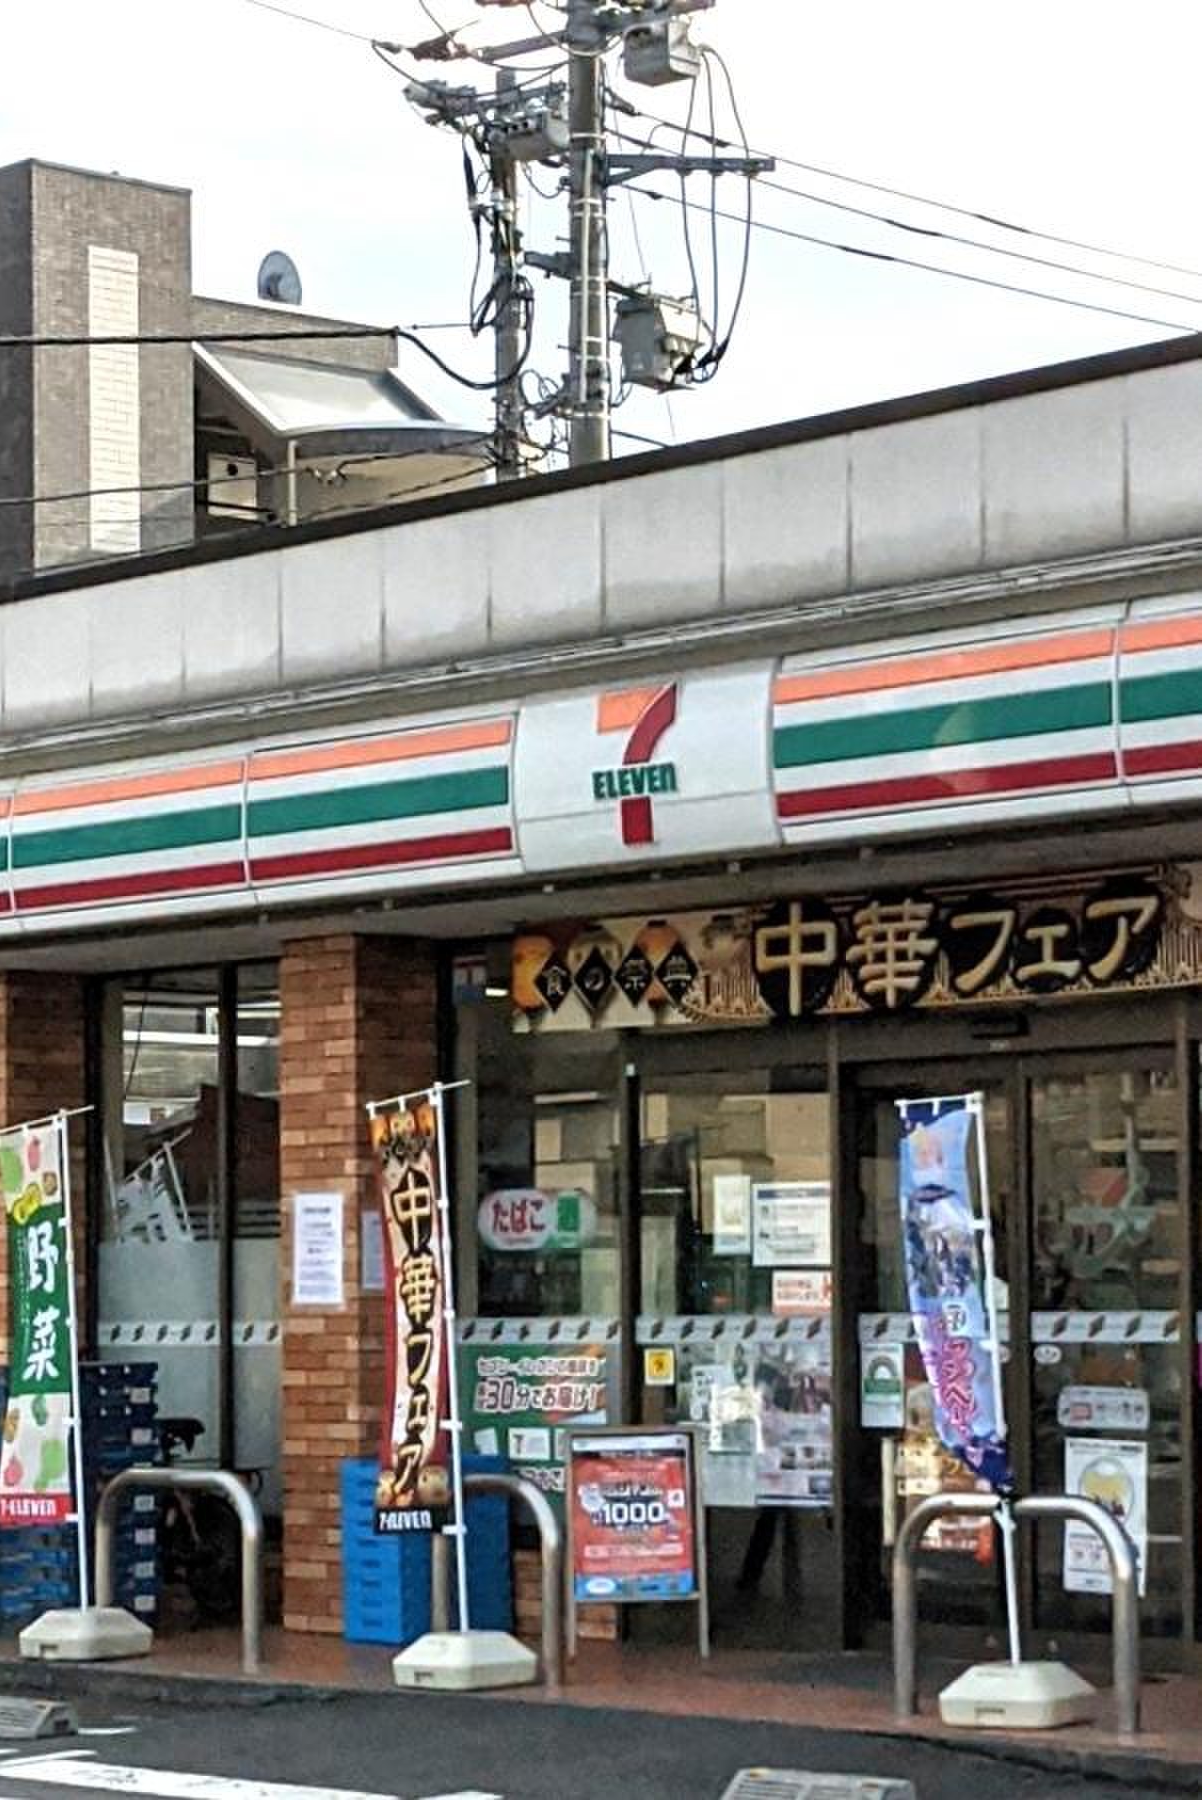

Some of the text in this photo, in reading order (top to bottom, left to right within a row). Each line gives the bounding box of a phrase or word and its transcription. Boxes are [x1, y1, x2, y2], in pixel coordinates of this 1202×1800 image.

[755, 895, 1160, 1016] 中華フェア
[492, 1198, 546, 1234] たばこ
[21, 1220, 61, 1382] 野菜
[395, 1170, 435, 1494] 中華フェア
[603, 1502, 664, 1524] 1000
